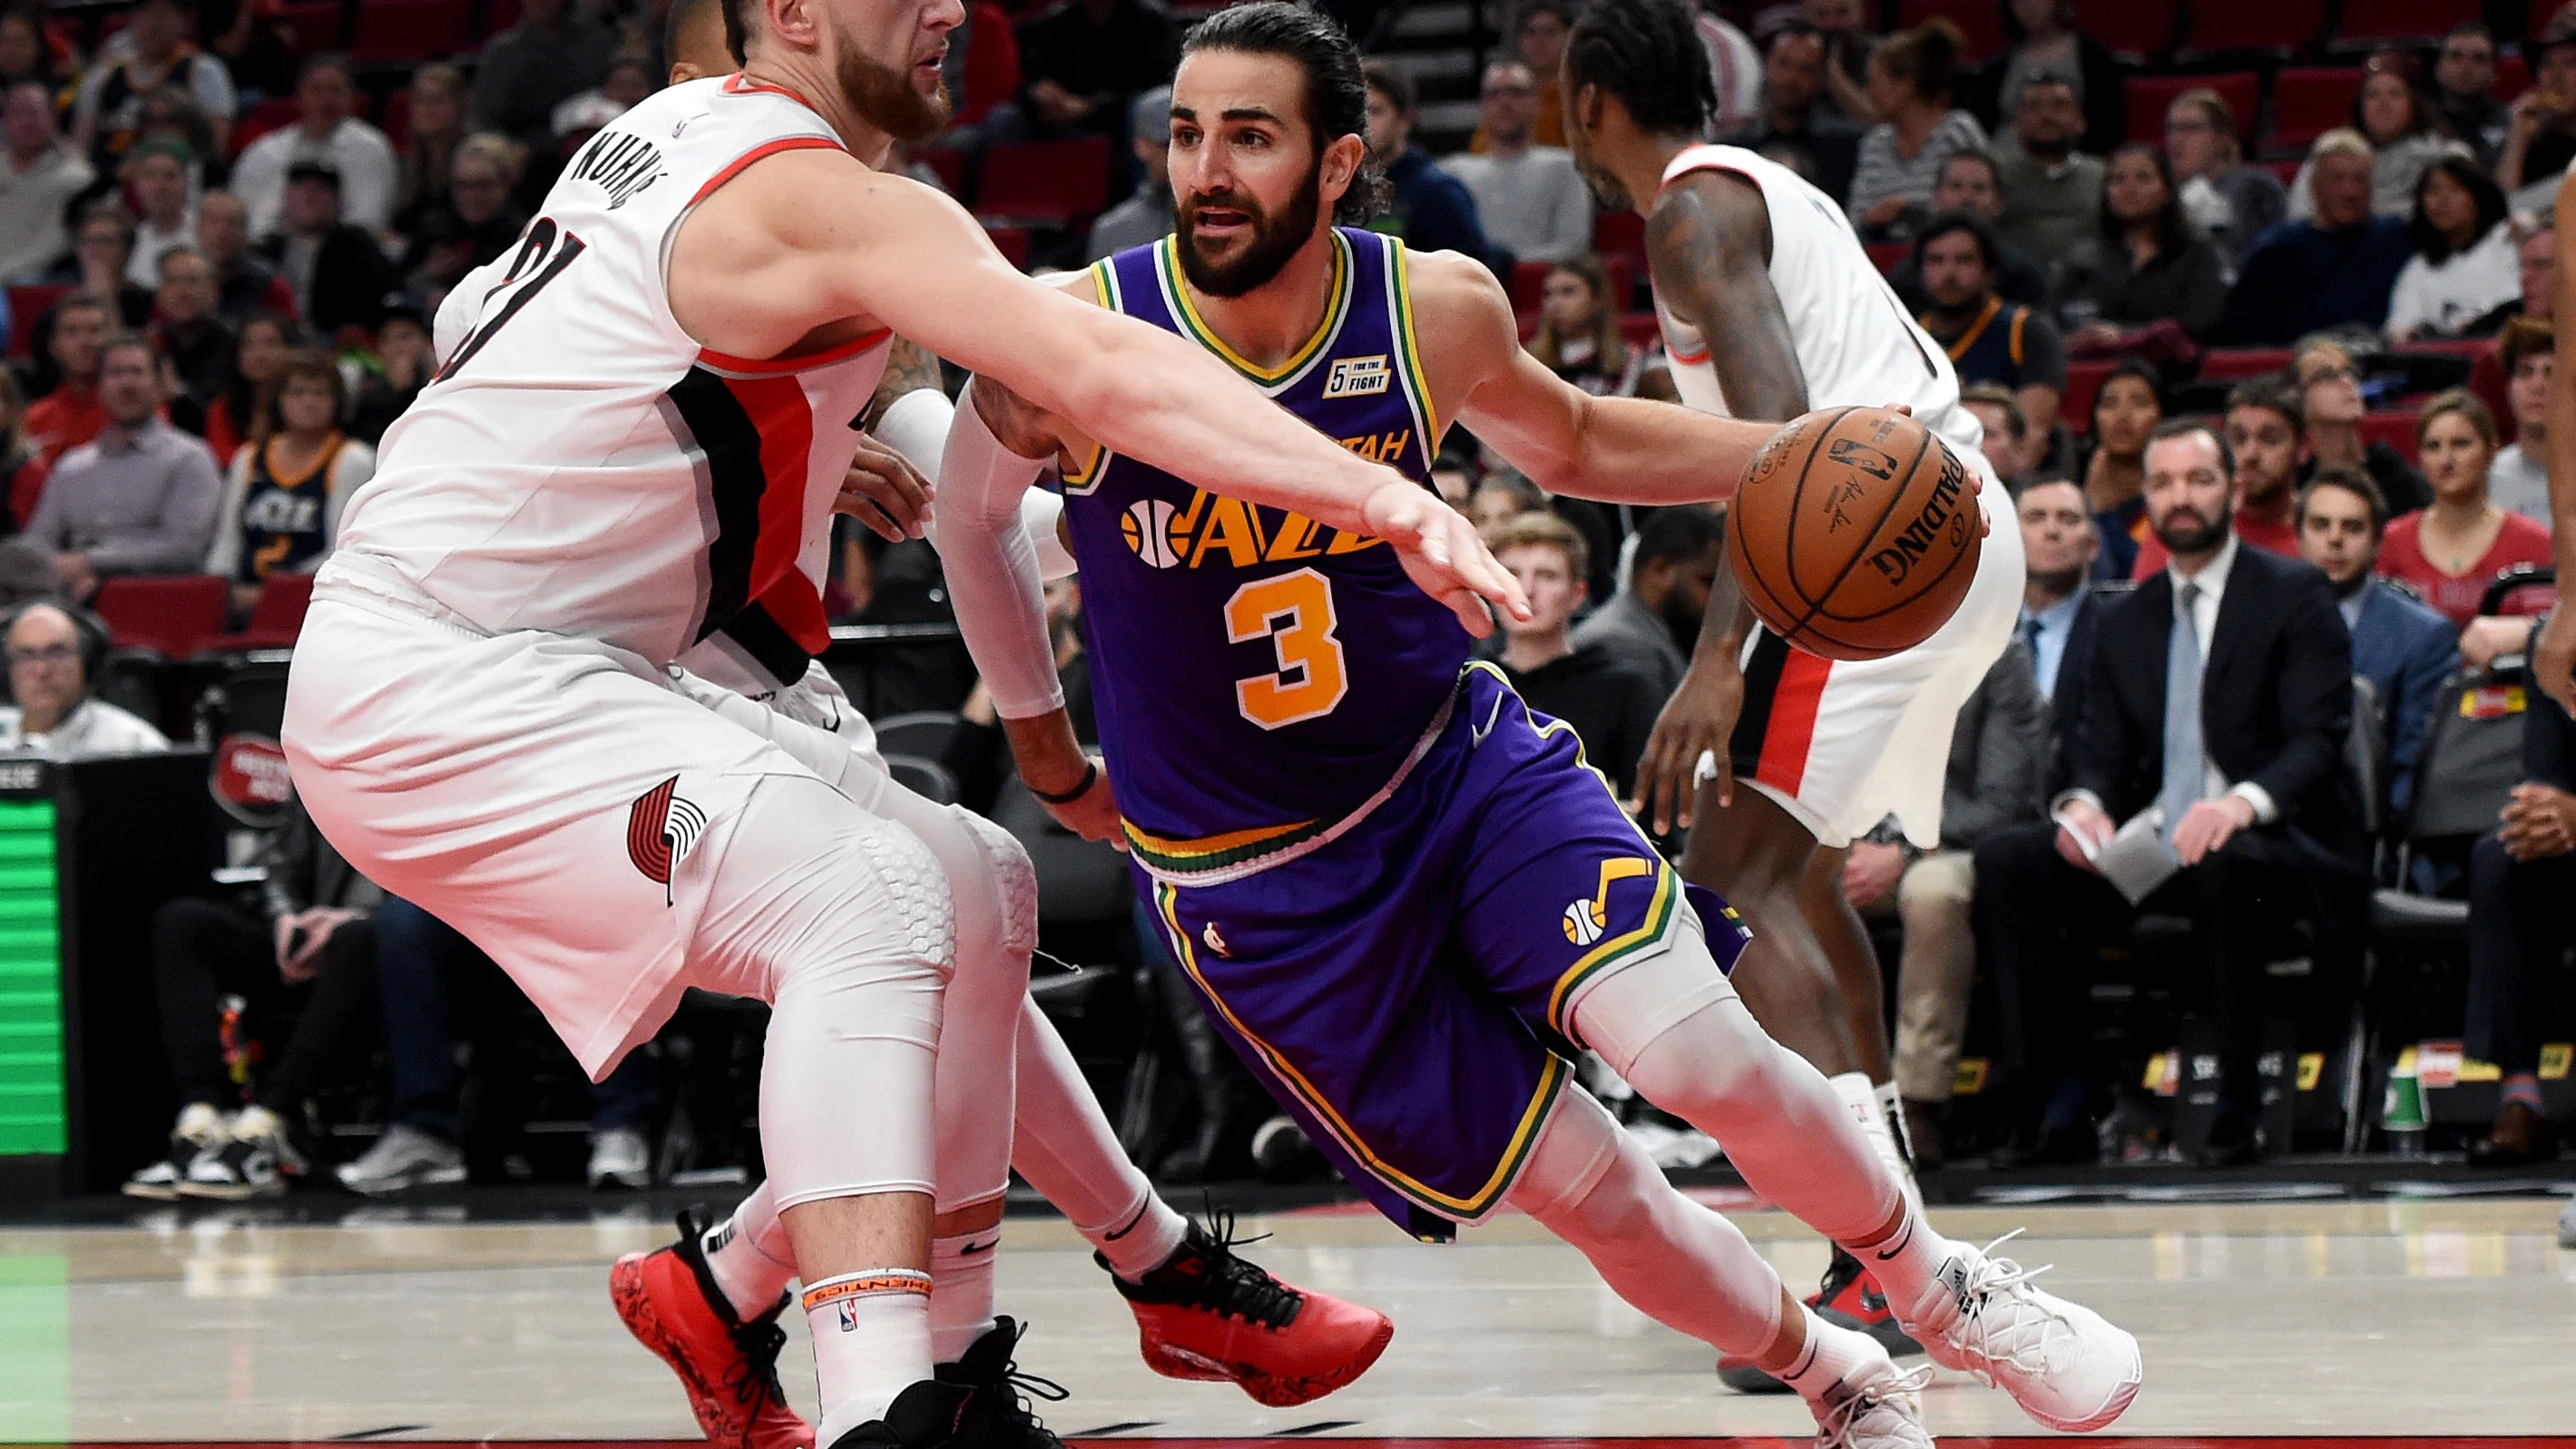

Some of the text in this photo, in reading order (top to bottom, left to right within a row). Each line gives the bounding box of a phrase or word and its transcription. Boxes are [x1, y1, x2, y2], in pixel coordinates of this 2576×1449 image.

[1330, 365, 1347, 393] 5
[1367, 361, 1380, 369] THE
[1349, 375, 1385, 391] FIGHT
[1341, 429, 1409, 462] TAH
[1223, 566, 1348, 730] 3
